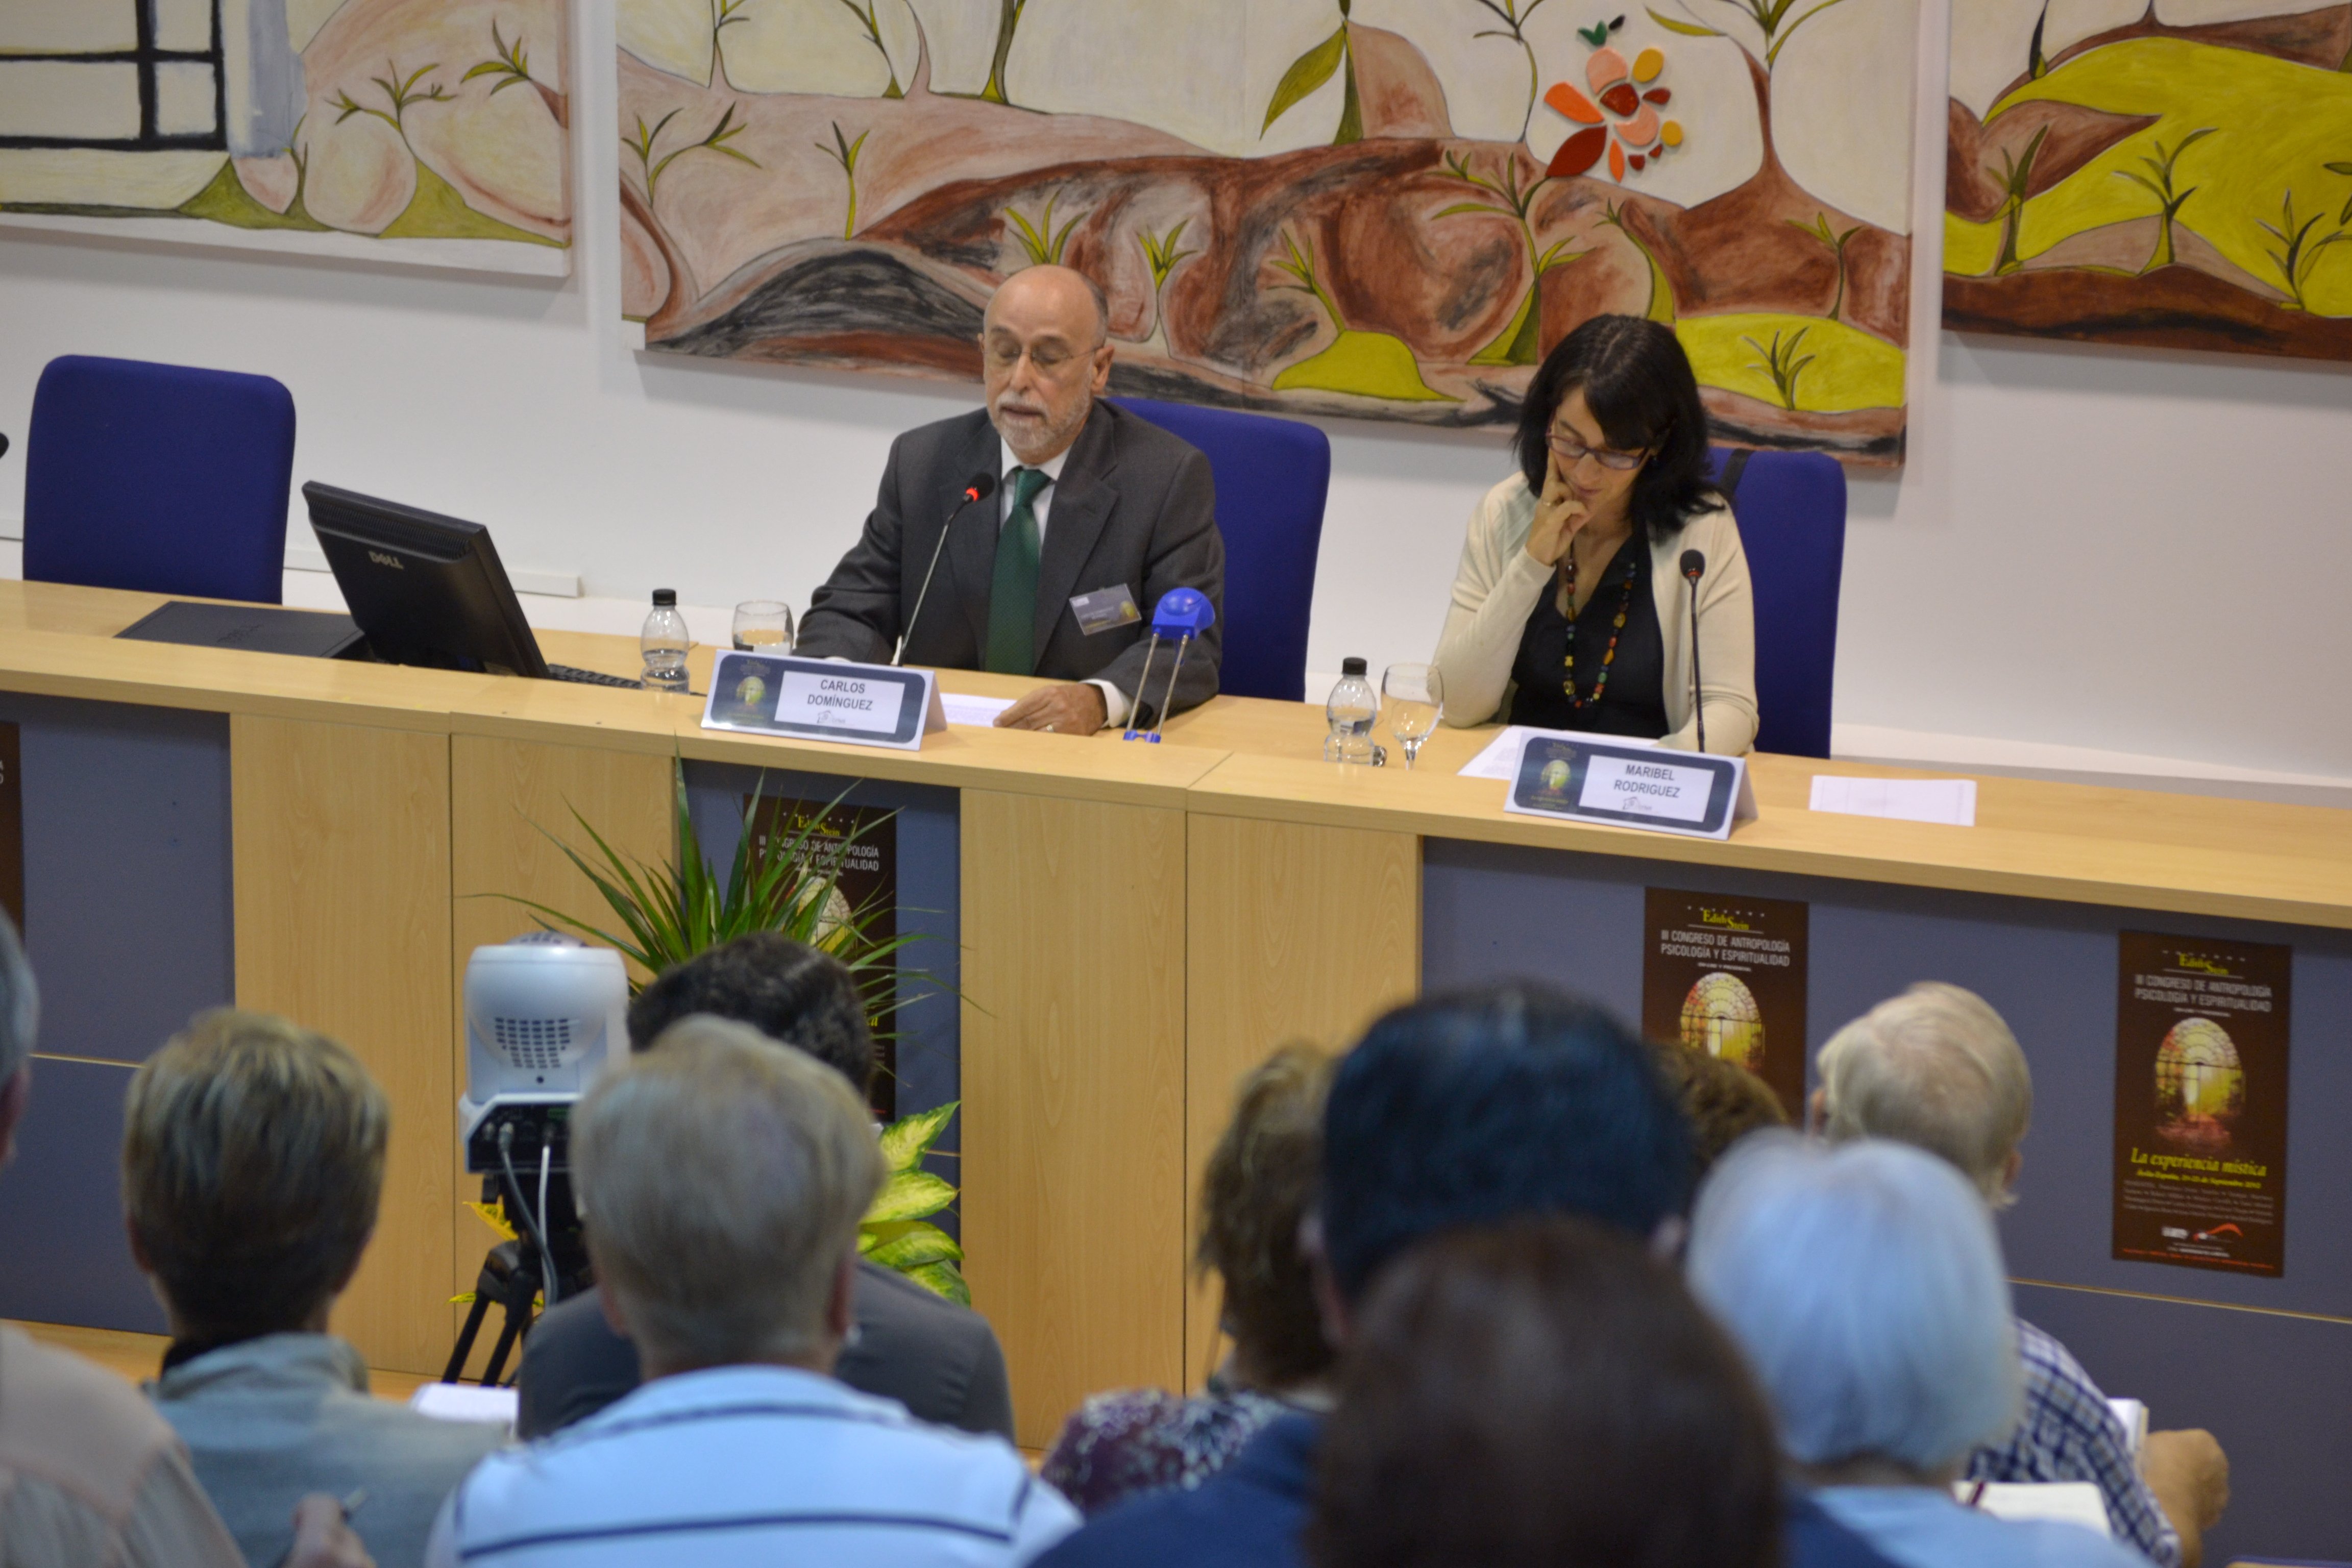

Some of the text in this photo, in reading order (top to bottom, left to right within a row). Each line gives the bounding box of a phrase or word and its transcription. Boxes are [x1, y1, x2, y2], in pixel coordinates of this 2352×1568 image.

[369, 551, 404, 569] DELL
[820, 679, 865, 693] CARLOS
[807, 693, 873, 710] DOMÍNGUEZ
[1625, 765, 1675, 780] MARIBEL
[1614, 780, 1680, 798] RODRIGUEZ
[1672, 931, 1715, 944] CONGRESO
[1717, 935, 1728, 947] DE
[1731, 938, 1790, 952] ANTROPOLOGÍA
[1661, 944, 1790, 966] PSICOLOGÍA Y ESPIRITUALIDAD
[2146, 975, 2193, 989] CONGRESO
[2194, 979, 2206, 991] DE
[2190, 993, 2197, 1003] Y
[2130, 1147, 2148, 1164] La
[2149, 1153, 2220, 1172] experiencia
[2222, 1158, 2268, 1177] mística
